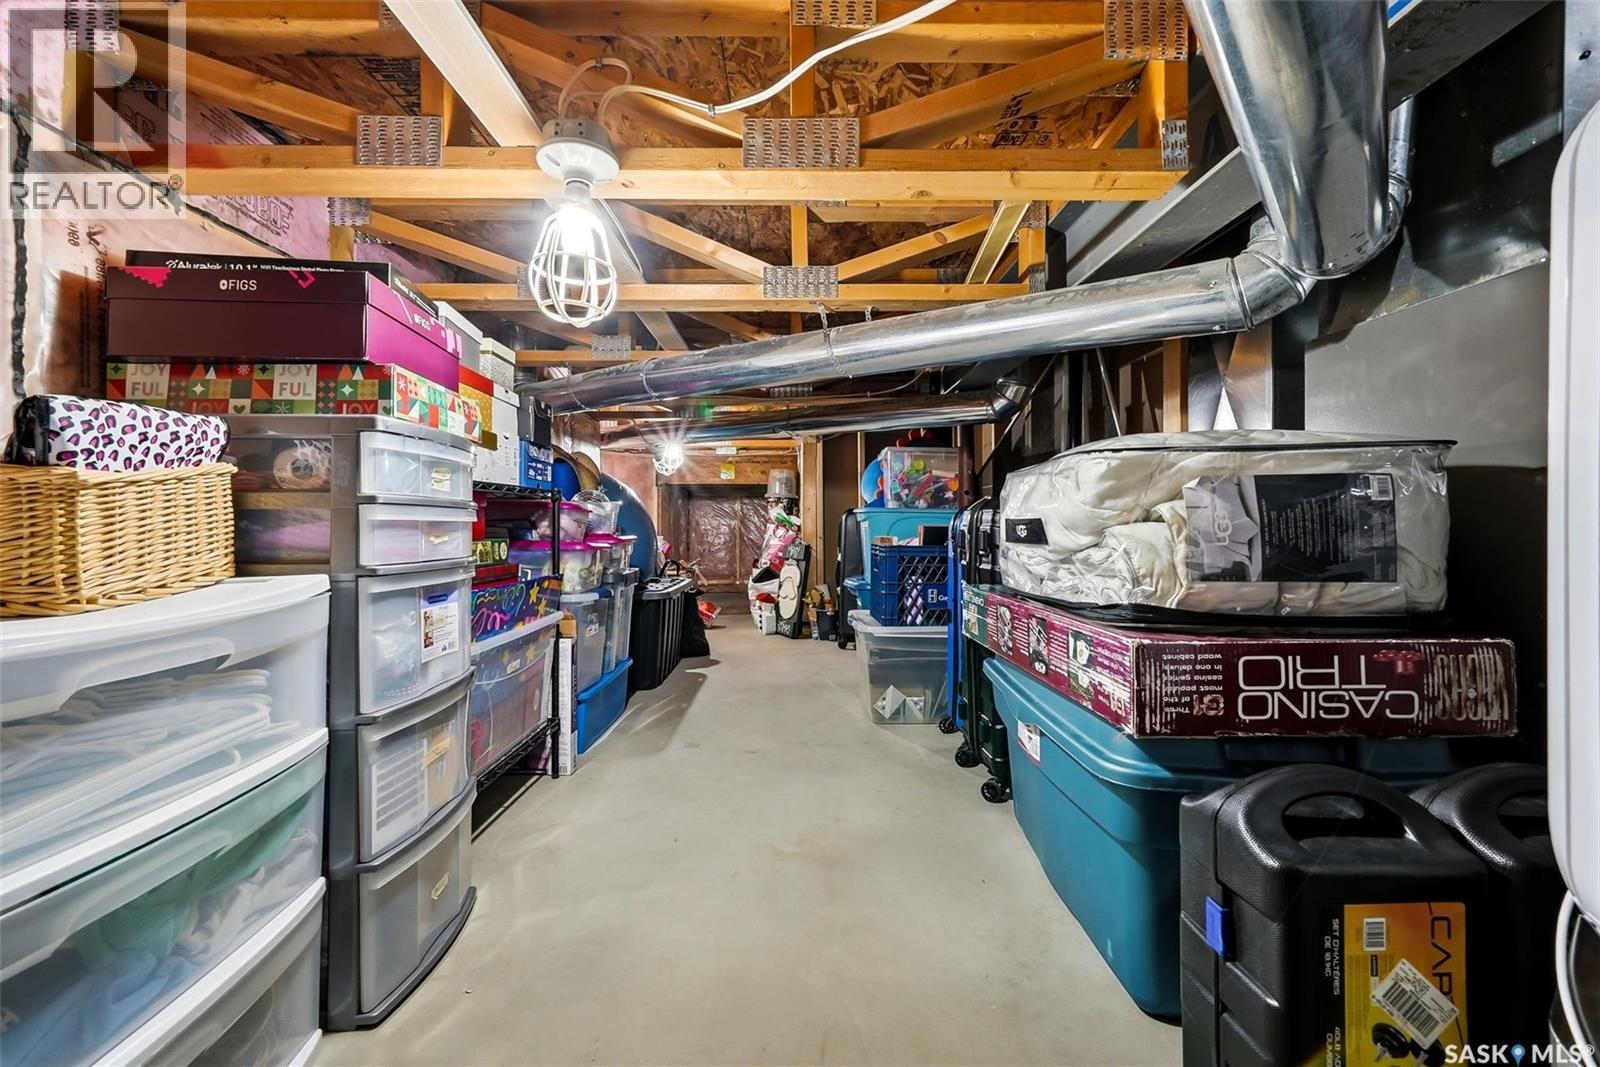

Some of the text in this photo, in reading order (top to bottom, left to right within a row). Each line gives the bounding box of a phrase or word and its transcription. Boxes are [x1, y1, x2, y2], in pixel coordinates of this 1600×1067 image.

[131, 364, 167, 377] JOY
[279, 363, 314, 377] JOY
[131, 382, 164, 396] FUL
[278, 382, 312, 396] FUL
[1237, 654, 1387, 690] TRIO
[1237, 689, 1420, 720] CASINO
